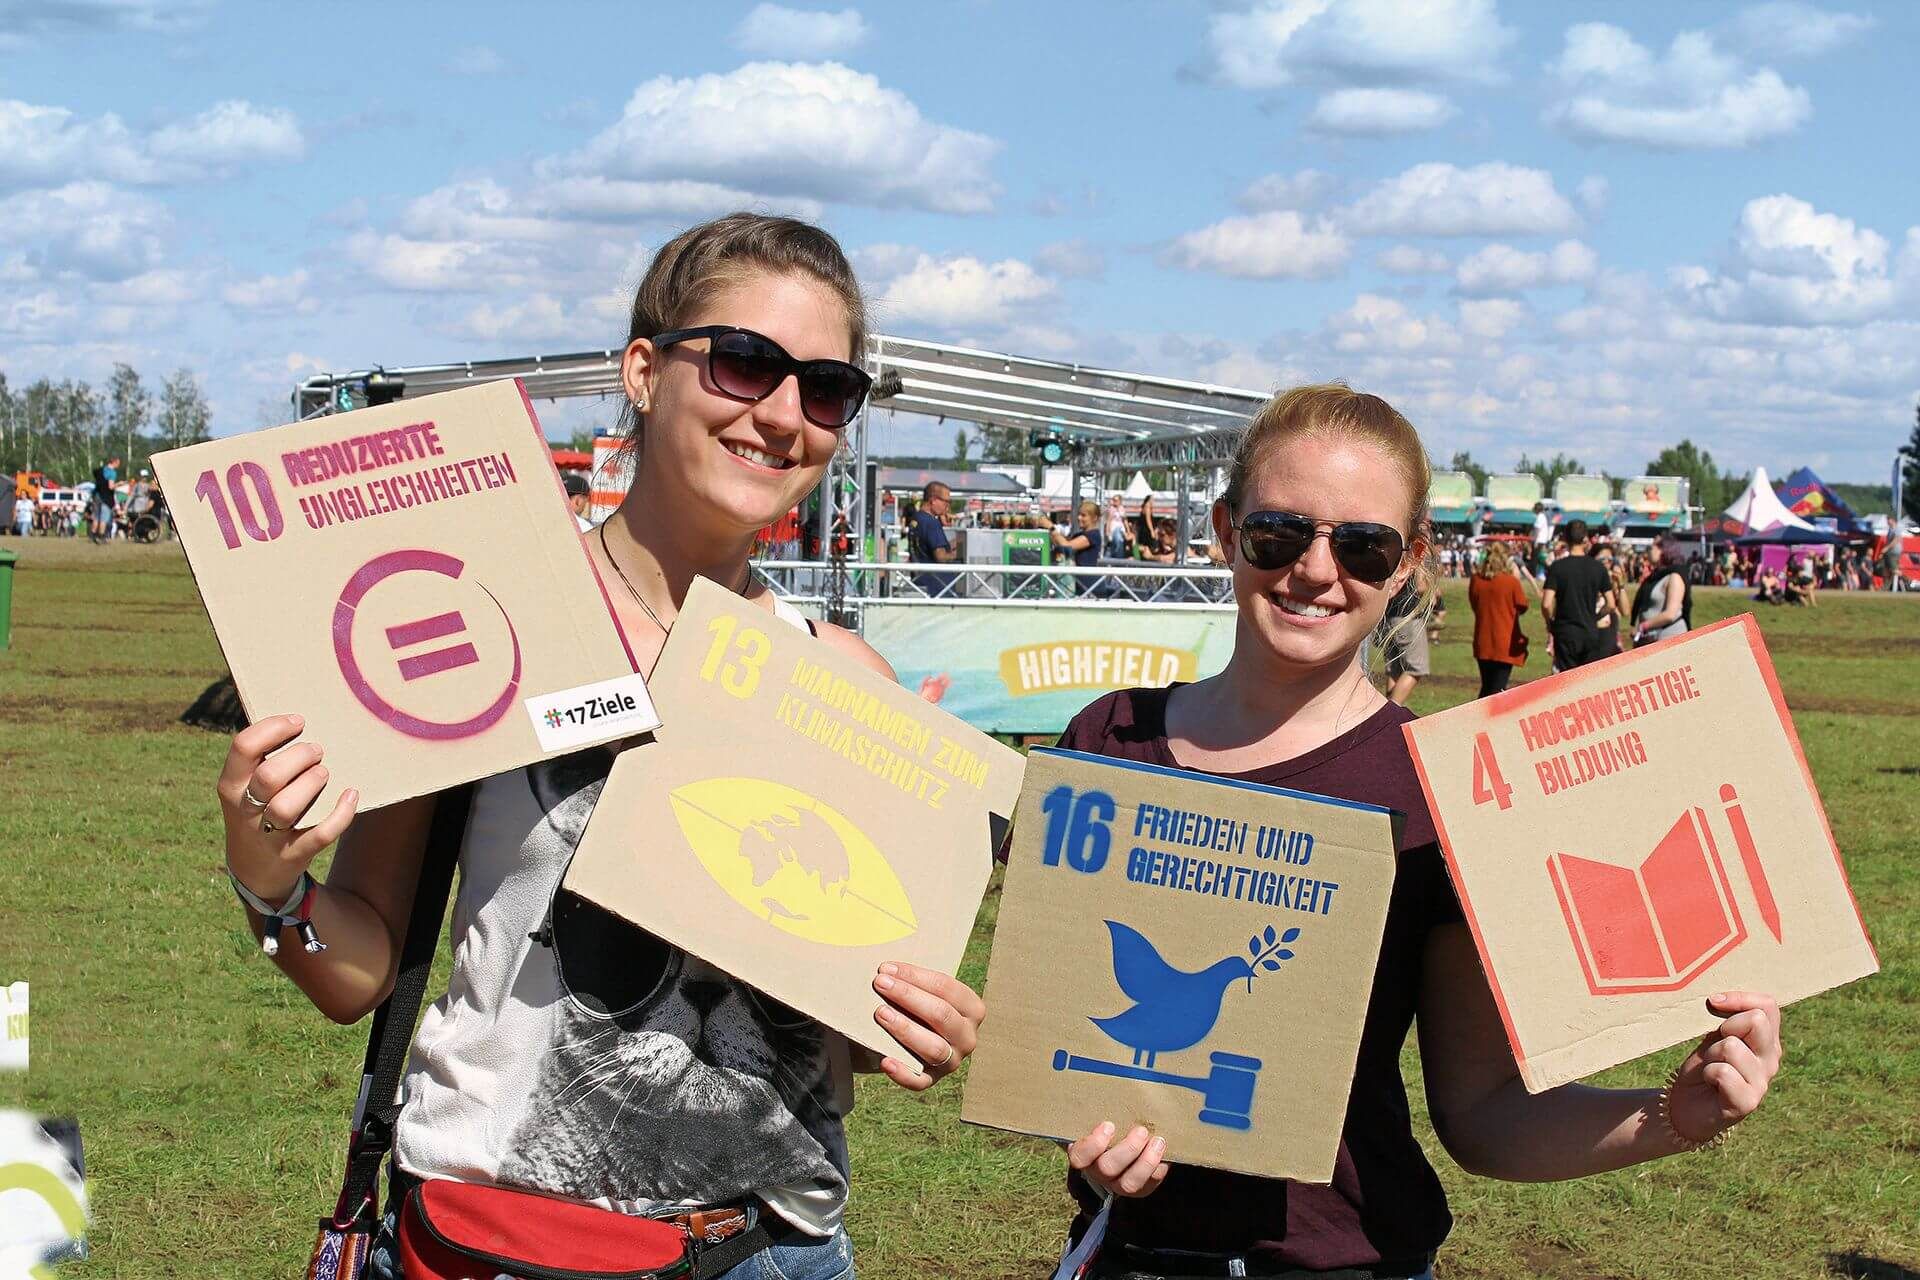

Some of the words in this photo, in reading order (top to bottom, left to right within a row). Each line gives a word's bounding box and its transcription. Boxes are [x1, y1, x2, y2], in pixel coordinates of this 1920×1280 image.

[281, 421, 445, 487] REDUZIERTE
[298, 452, 517, 530] UNGLEICHHEITEN
[195, 462, 284, 550] 10
[699, 613, 772, 699] 13
[1018, 646, 1180, 690] HIGHFIELD
[1518, 666, 1700, 751] HOCHWERTIGE
[776, 692, 950, 809] KLIMASCHUTZ
[934, 737, 991, 790] ZUM
[1473, 732, 1513, 810] 4
[1535, 731, 1647, 795] BILDUNG
[1041, 785, 1116, 874] 16
[1134, 803, 1248, 854] FRIEDEN
[1255, 825, 1315, 866] UND
[1126, 847, 1339, 915] GERECHTIGKEIT
